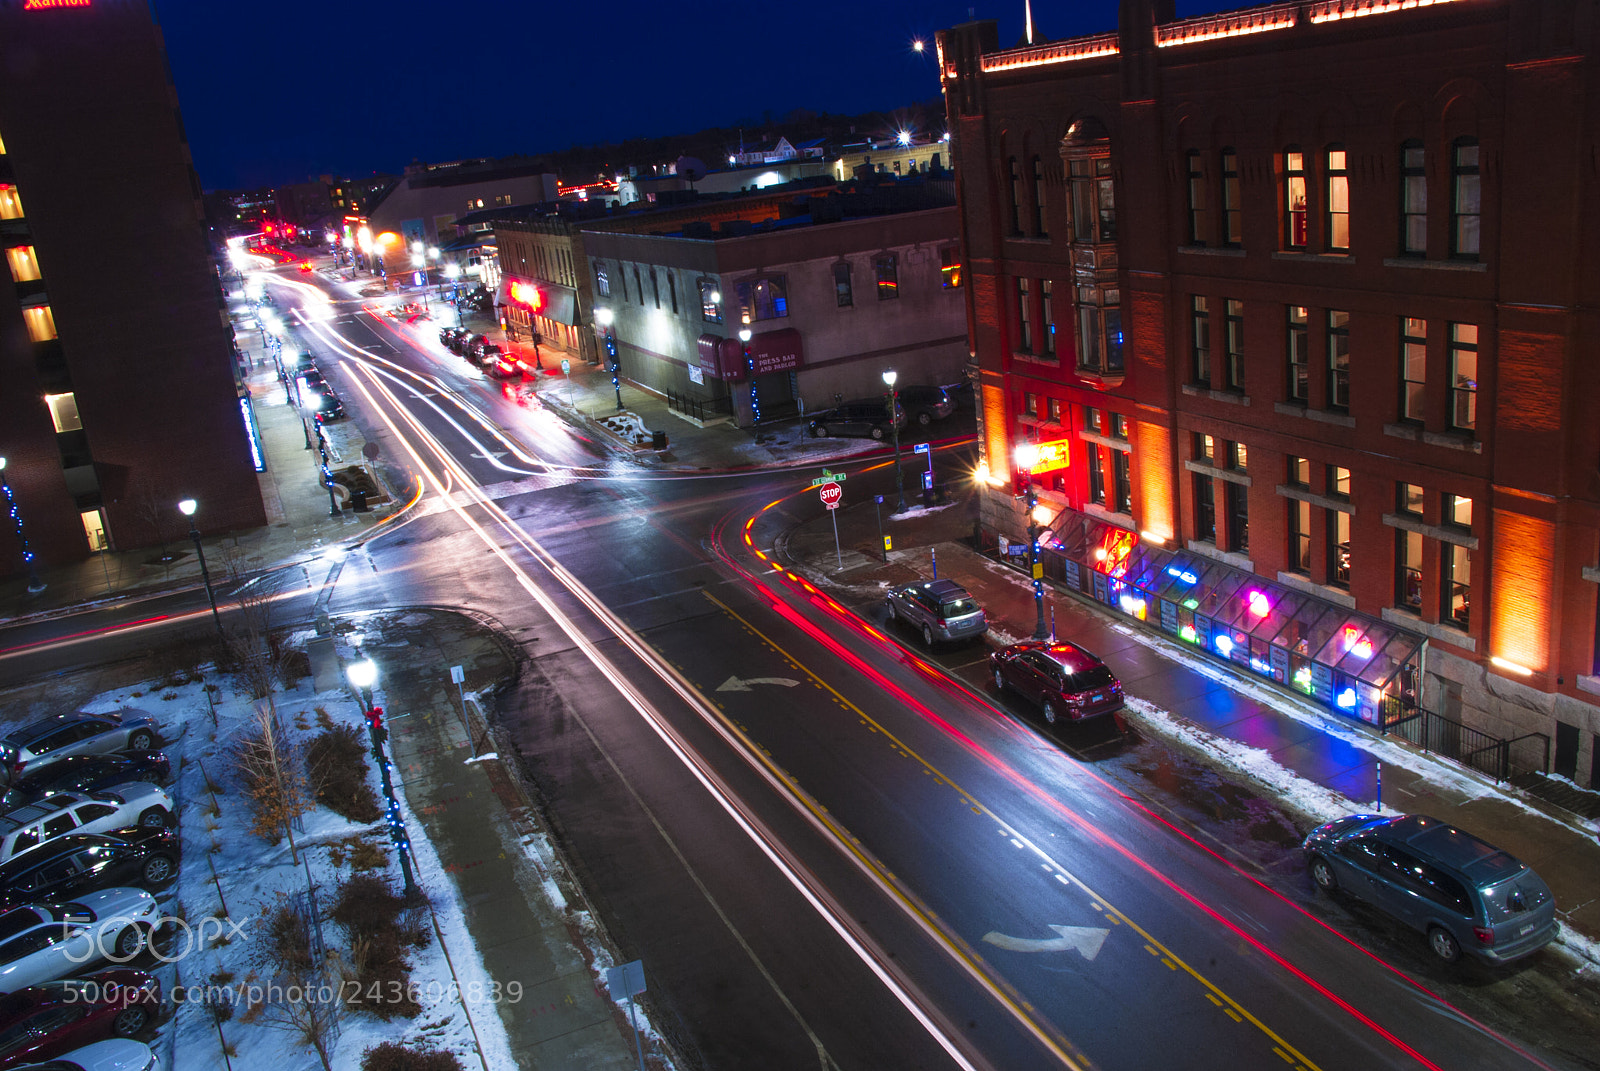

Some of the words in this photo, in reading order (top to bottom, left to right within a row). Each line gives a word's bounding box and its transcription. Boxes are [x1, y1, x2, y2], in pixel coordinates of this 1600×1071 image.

[759, 357, 781, 367] PRESS
[783, 354, 796, 362] BAR
[822, 487, 840, 499] STOP
